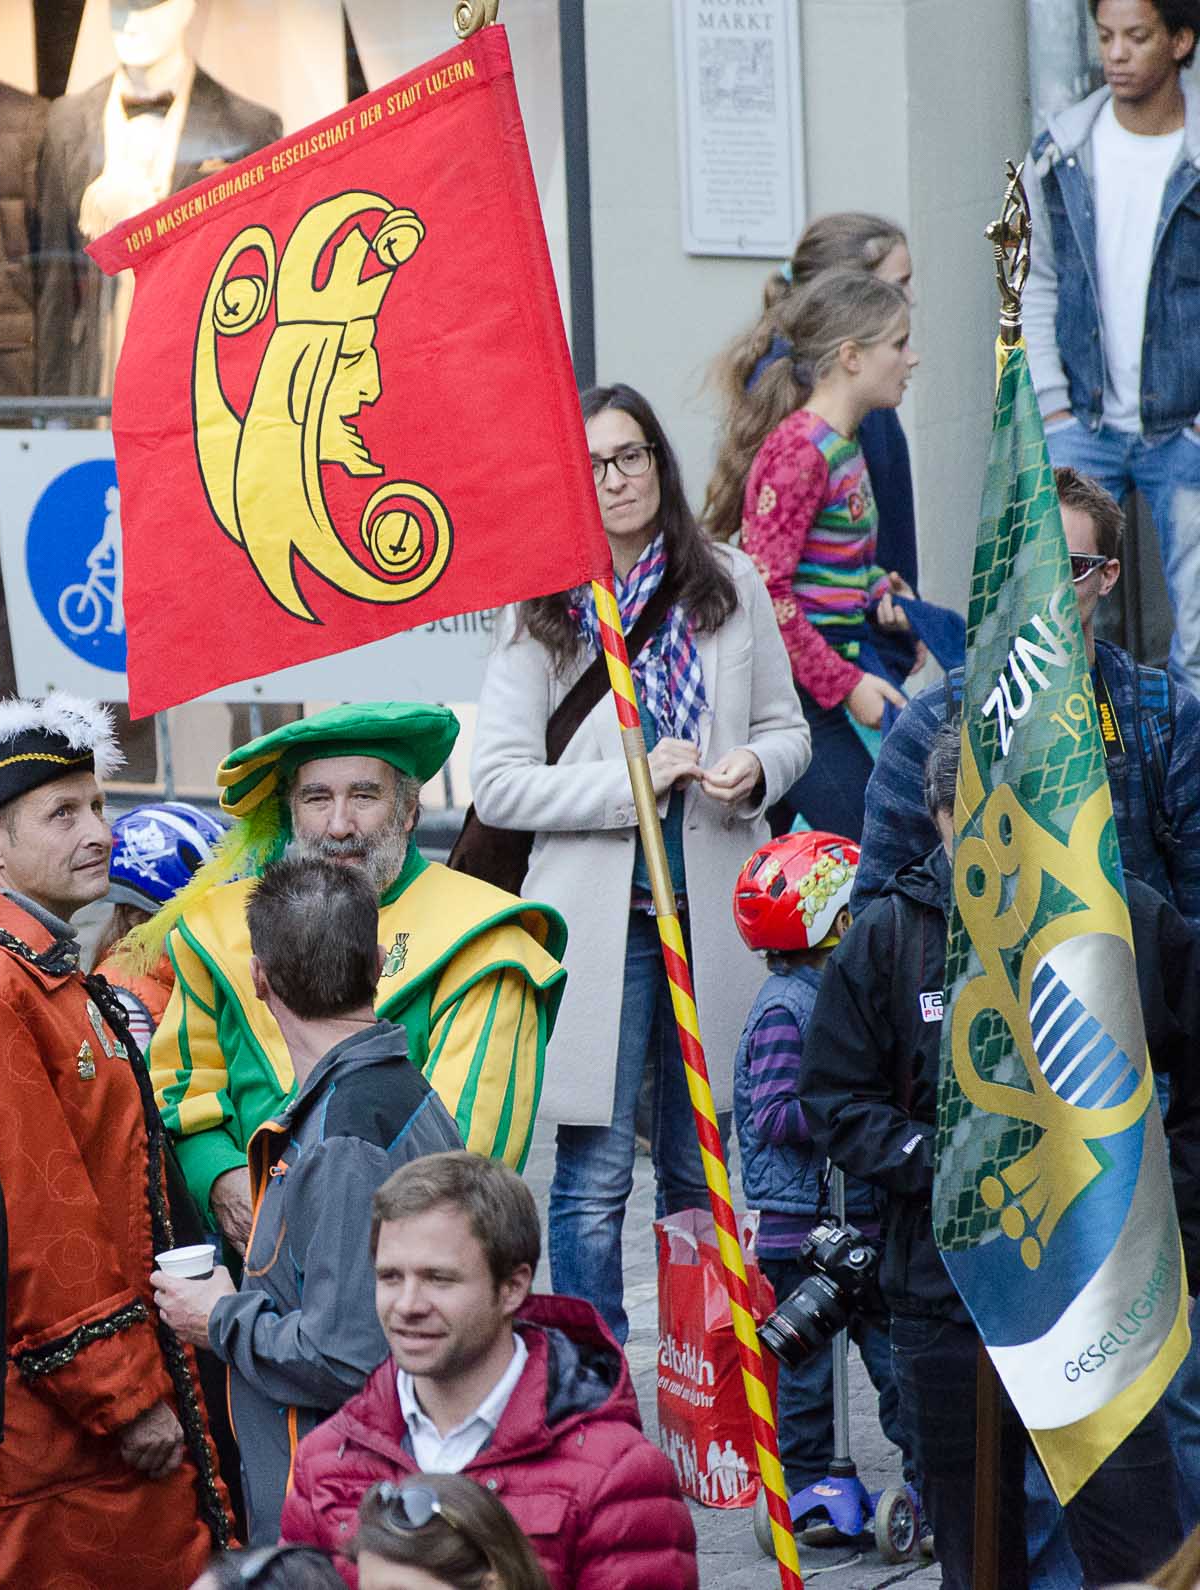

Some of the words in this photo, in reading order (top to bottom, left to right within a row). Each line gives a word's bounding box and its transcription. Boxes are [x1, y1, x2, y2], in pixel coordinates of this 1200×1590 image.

[697, 12, 775, 30] MARKT
[124, 226, 153, 254] 1819
[155, 117, 355, 238] MASKENLIEBHABER-GESELLSCHAFT
[360, 103, 382, 131] DER
[386, 81, 422, 116] STADT
[425, 59, 475, 96] LUZERN
[1100, 703, 1117, 742] Nikon
